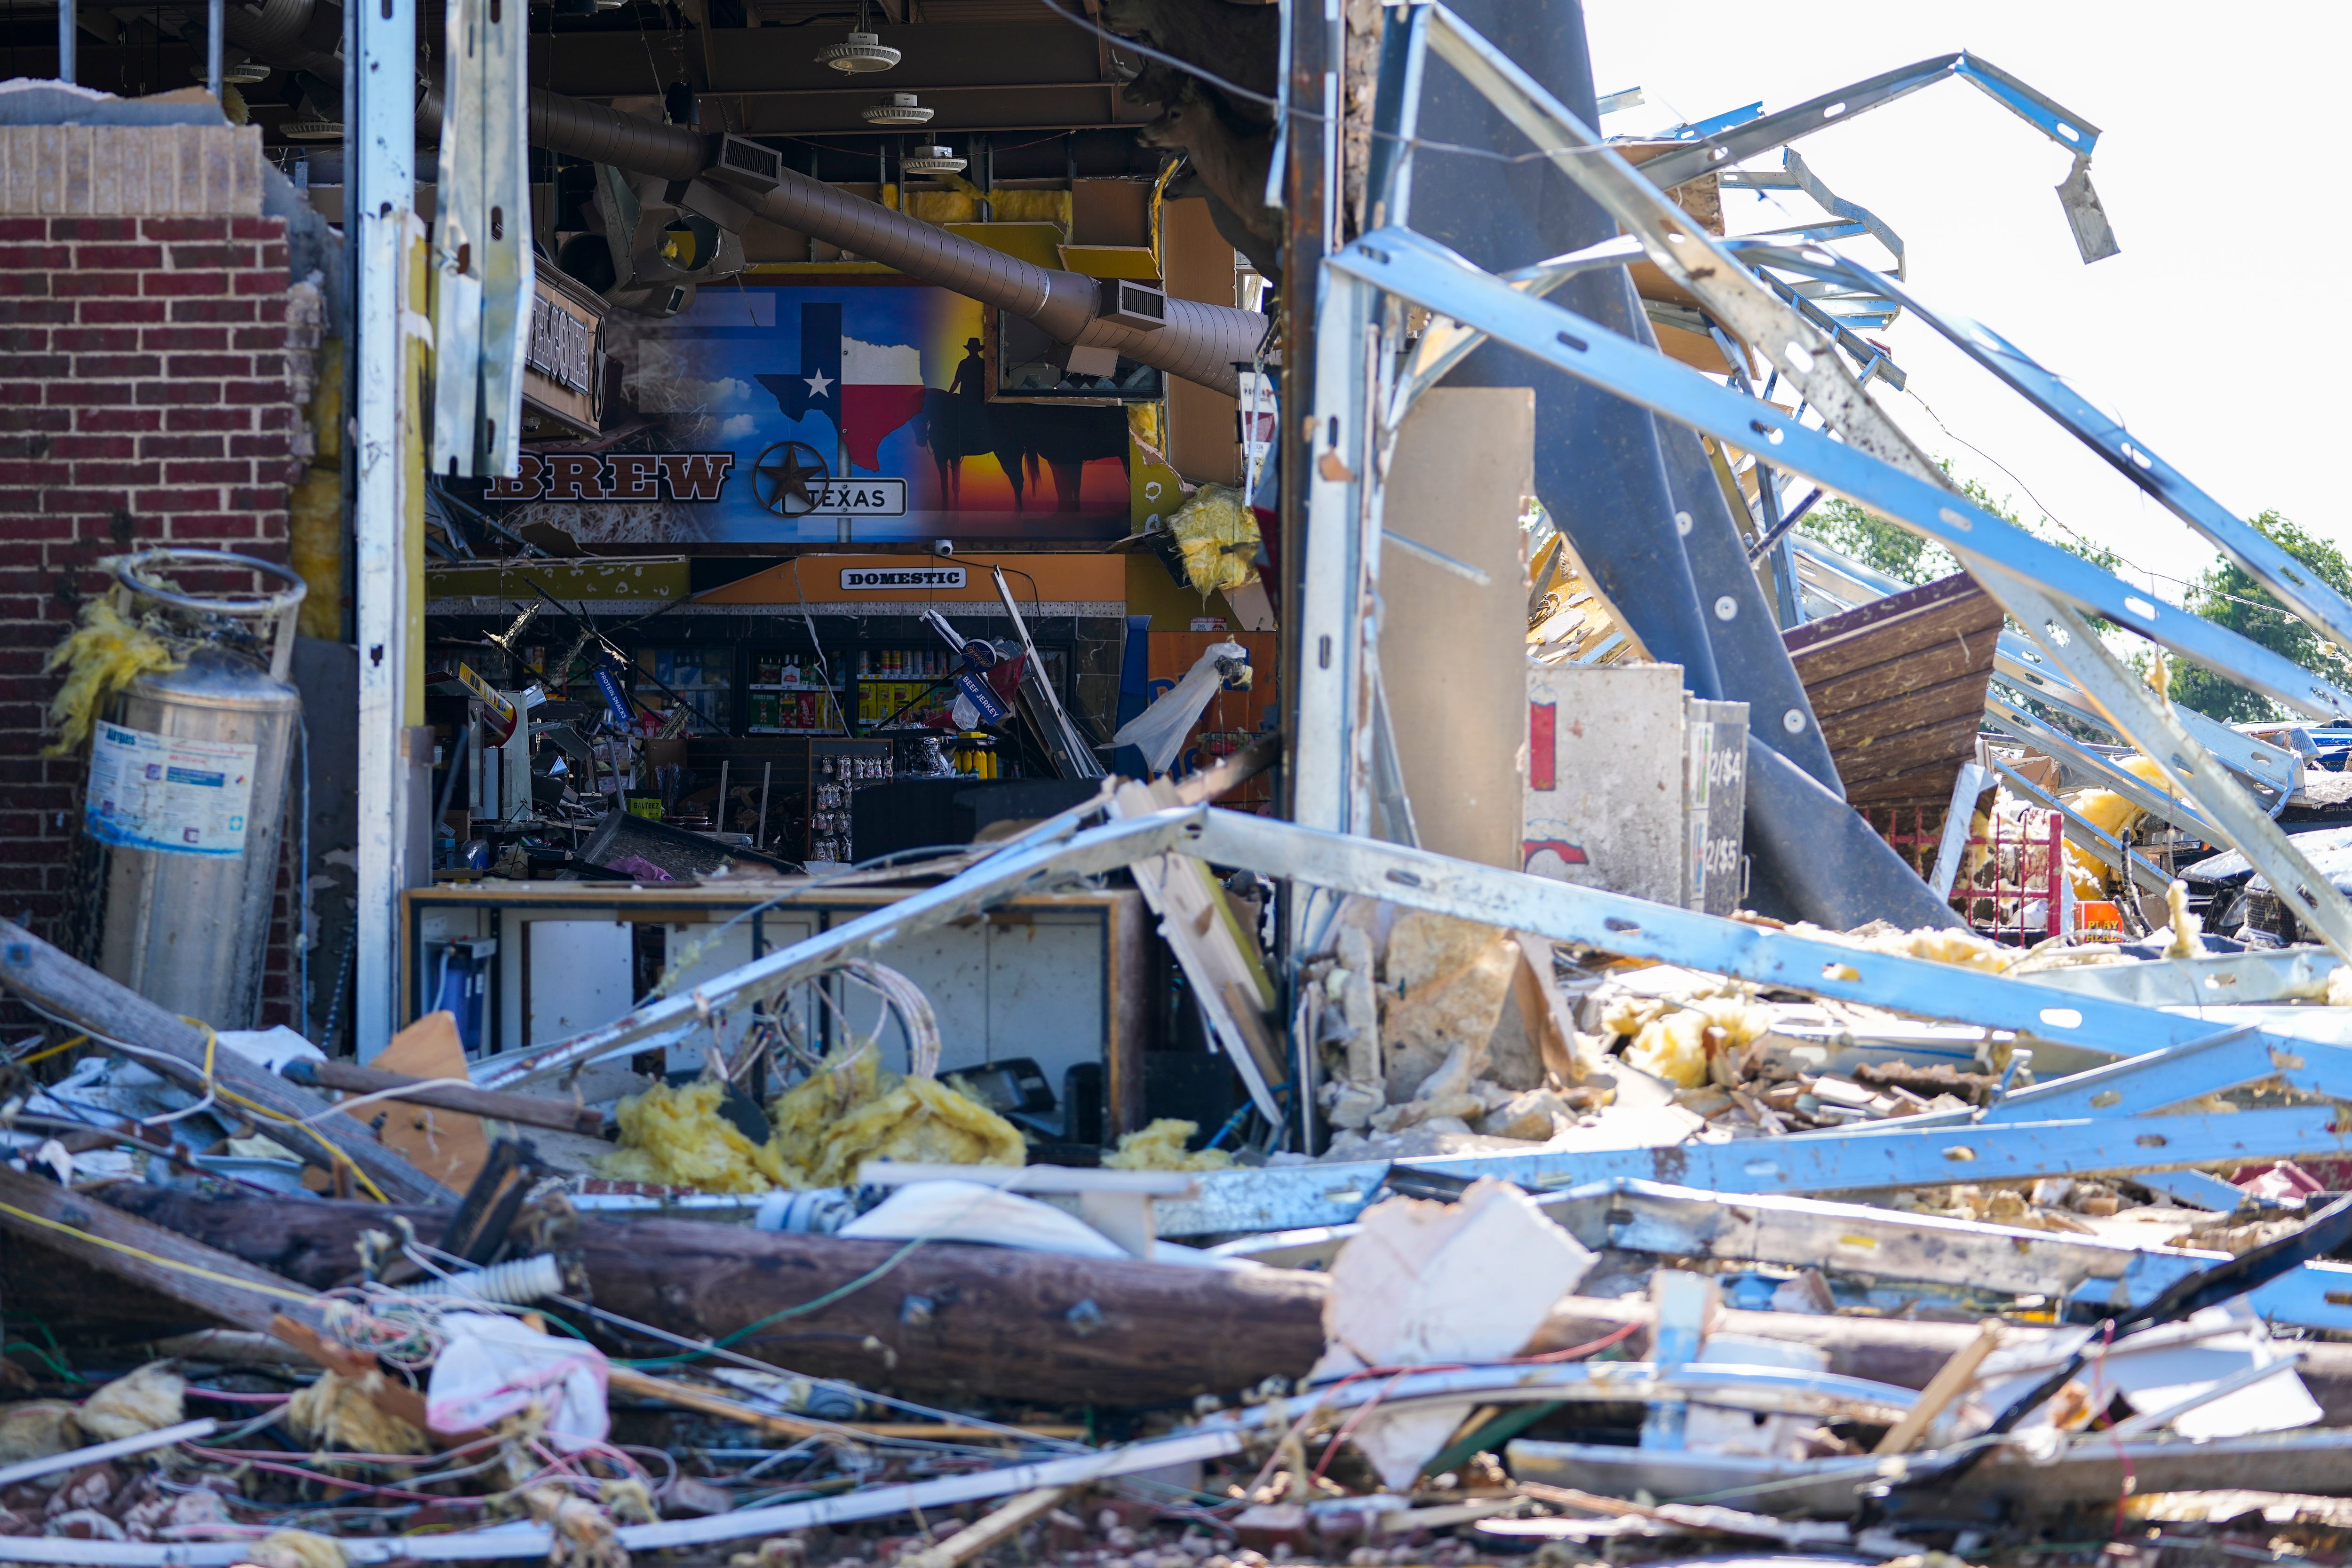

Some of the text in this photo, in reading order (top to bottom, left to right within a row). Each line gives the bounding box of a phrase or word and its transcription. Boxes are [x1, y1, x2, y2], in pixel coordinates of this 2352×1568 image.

[484, 455, 732, 500] BREW
[807, 490, 885, 507] TEXAS
[848, 572, 960, 585] DOMESTIC
[966, 646, 991, 667] GATEWAY
[599, 671, 627, 719] PROTEIN SNACKS
[962, 676, 1000, 718] BEEF JERKEY
[1709, 747, 1742, 786] 2/$4
[1706, 835, 1738, 875] 2/$5
[2087, 920, 2119, 929] PLAY
